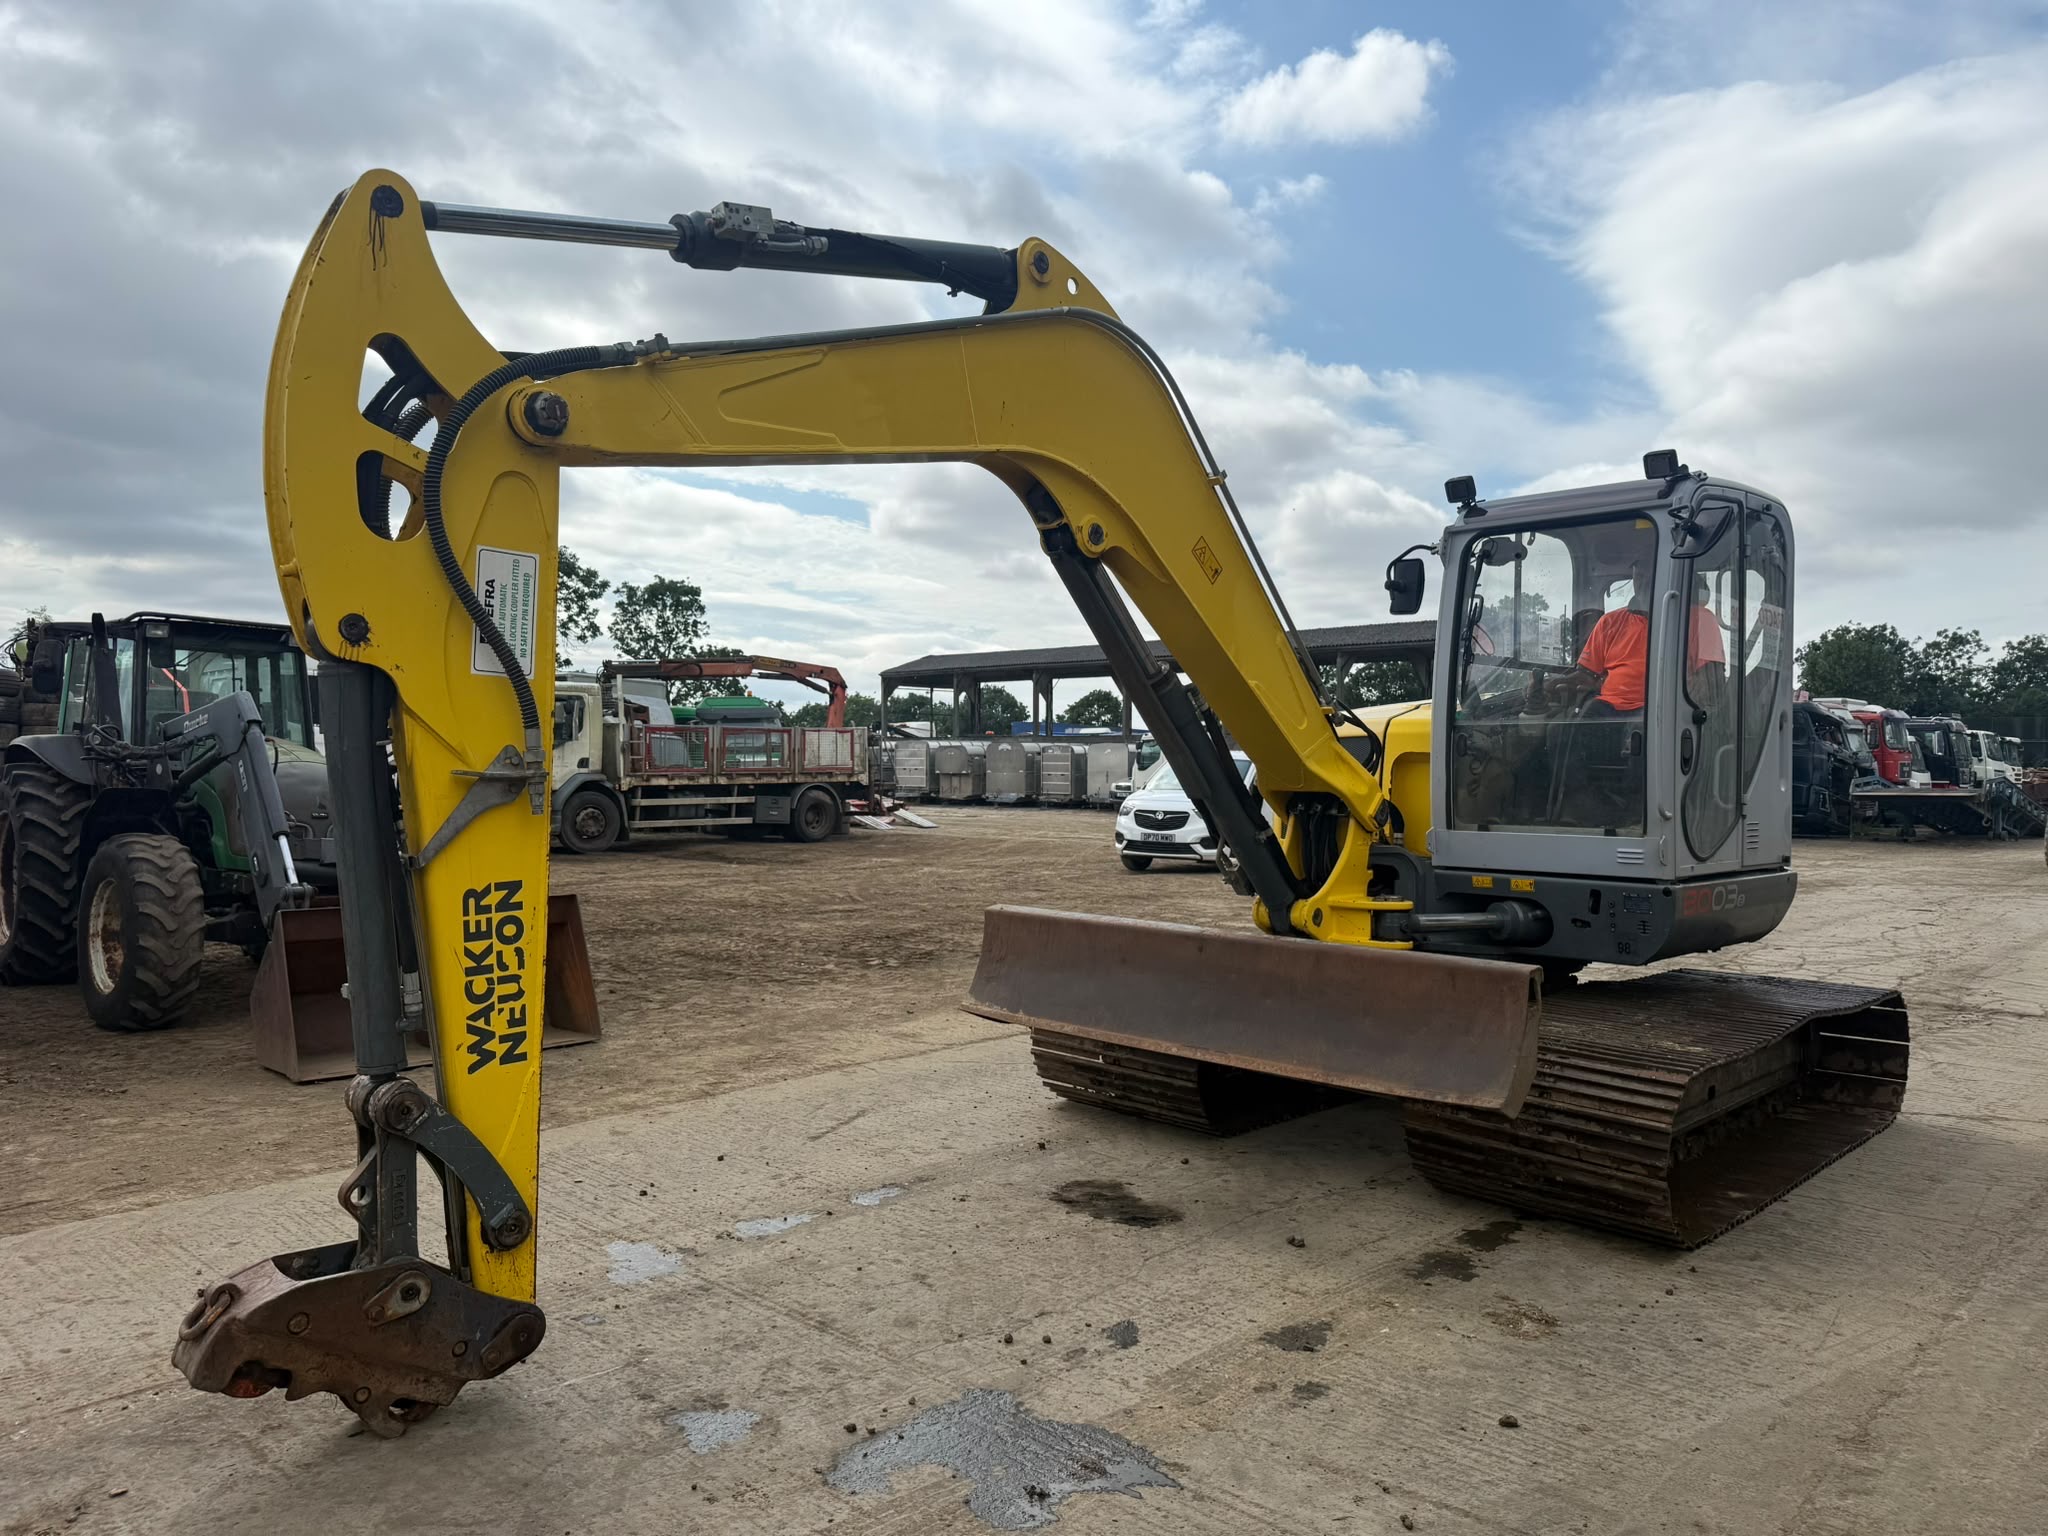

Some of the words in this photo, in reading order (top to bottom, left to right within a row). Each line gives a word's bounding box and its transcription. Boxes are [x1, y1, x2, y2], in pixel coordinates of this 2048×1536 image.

[512, 559, 520, 582] FITTED
[485, 579, 495, 618] EFRA
[499, 583, 508, 621] AUTOMATIC
[511, 582, 519, 613] COUPLER
[523, 572, 531, 608] REQUIRED
[510, 613, 518, 642] LOCKING
[520, 648, 527, 658] NO
[462, 882, 497, 1075] WACKER
[494, 880, 528, 1066] NEUSON
